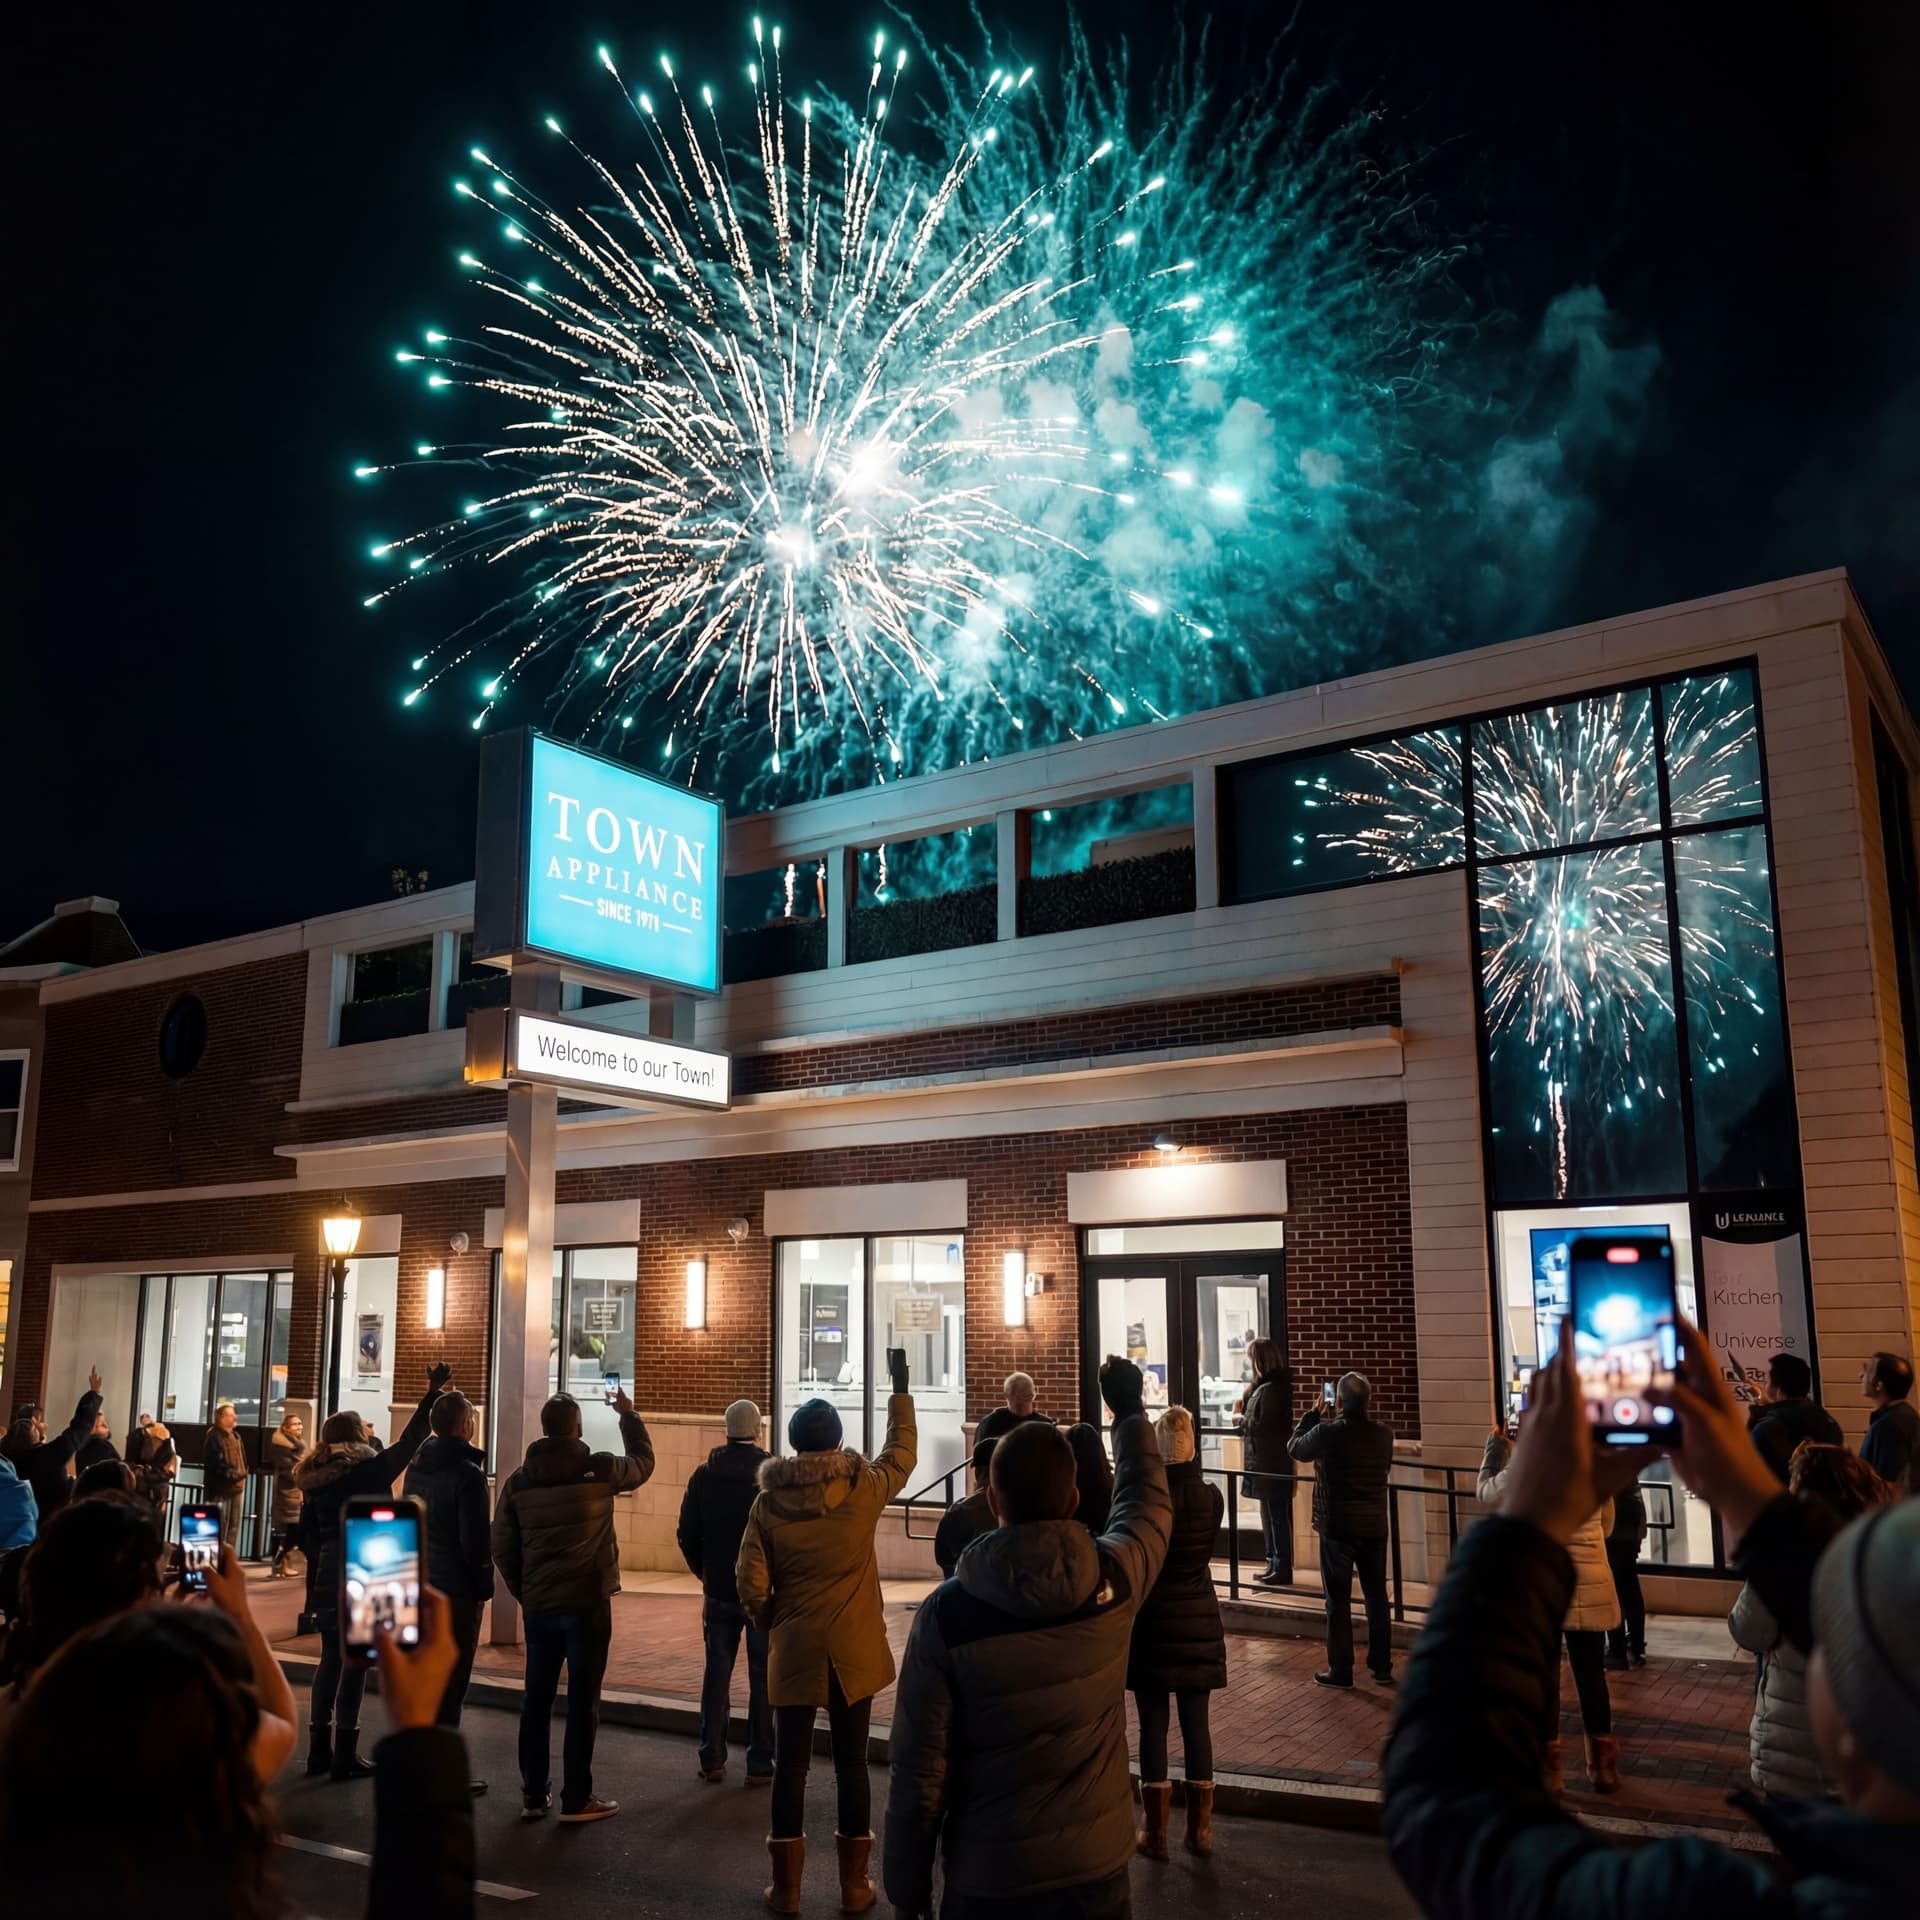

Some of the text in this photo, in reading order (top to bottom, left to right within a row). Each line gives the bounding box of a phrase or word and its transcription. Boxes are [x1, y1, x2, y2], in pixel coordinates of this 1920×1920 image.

[548, 791, 705, 886] TOWN
[546, 856, 703, 921] APPLIANCE
[597, 897, 632, 924] SINCE
[537, 1034, 715, 1087] Welcome to our Town!
[1713, 1288, 1783, 1305] Kitchen
[1715, 1331, 1796, 1349] Universe
